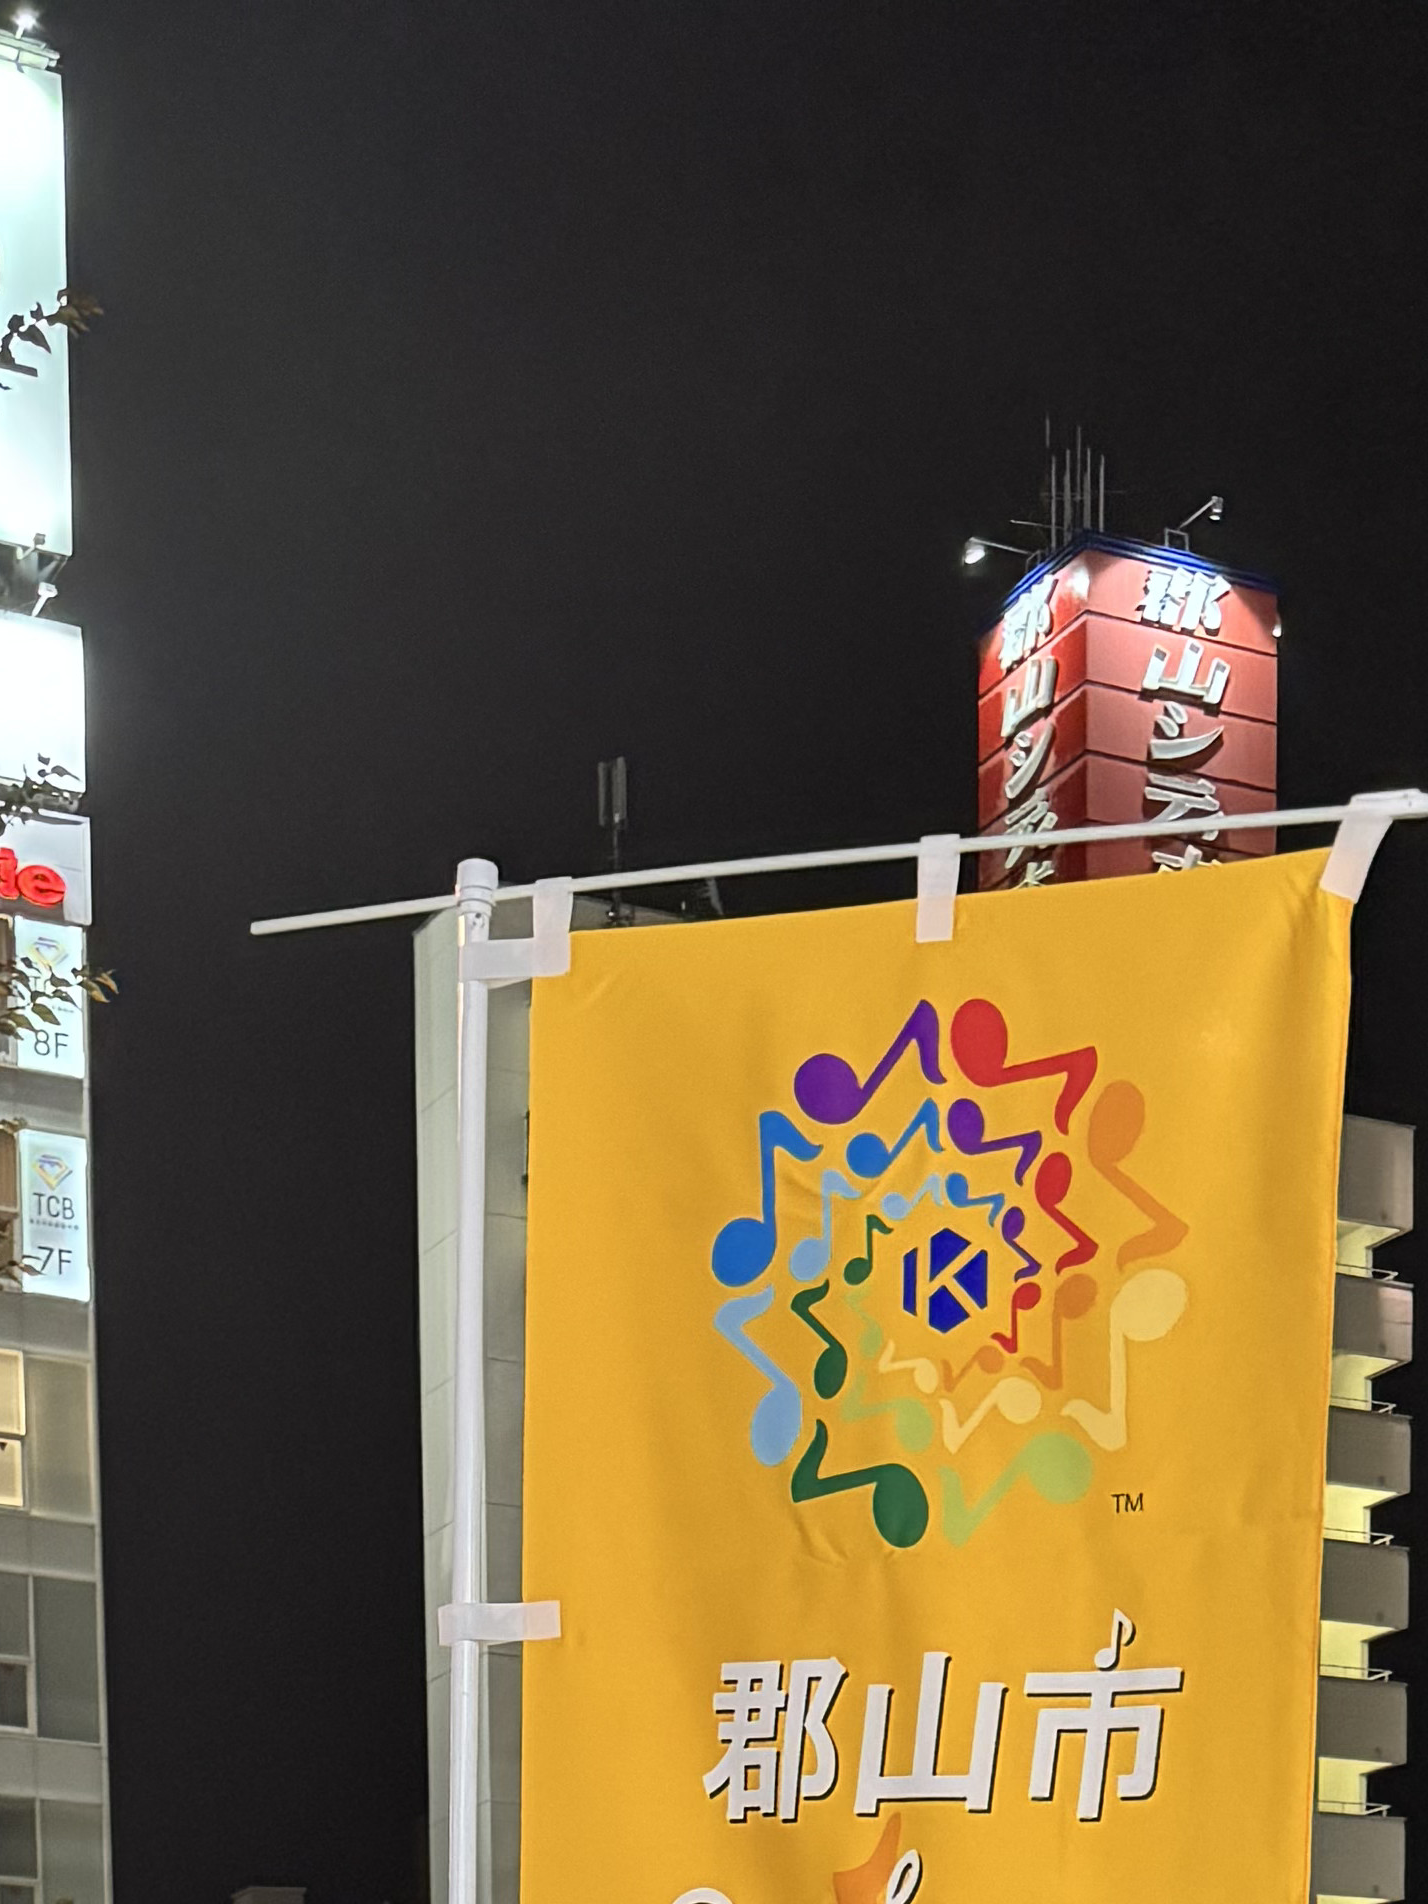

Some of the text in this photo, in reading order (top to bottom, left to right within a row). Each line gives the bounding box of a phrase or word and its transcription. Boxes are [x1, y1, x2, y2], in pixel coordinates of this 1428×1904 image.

[34, 1029, 69, 1058] 8F
[32, 1192, 75, 1221] TCB
[36, 1246, 72, 1275] 7F
[1112, 1494, 1145, 1513] TM
[703, 1612, 1183, 1824] 郡山市
